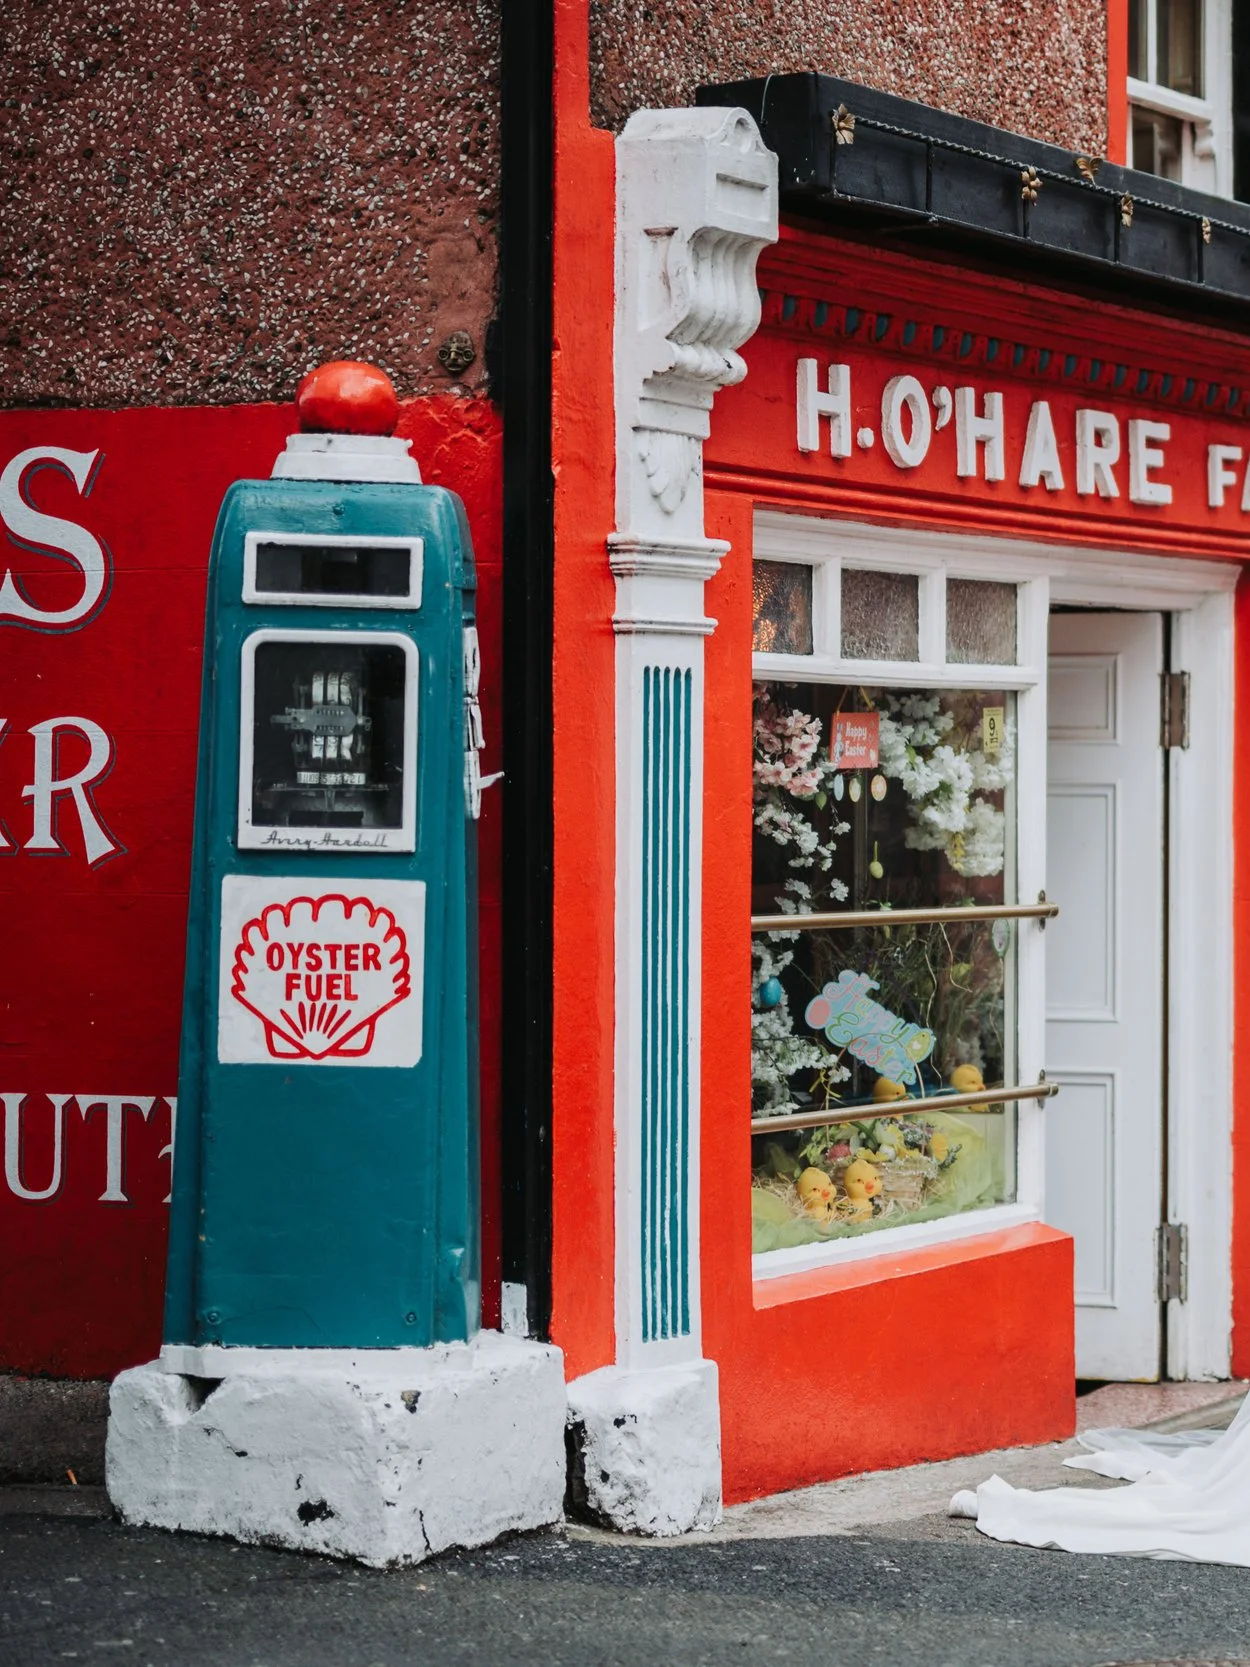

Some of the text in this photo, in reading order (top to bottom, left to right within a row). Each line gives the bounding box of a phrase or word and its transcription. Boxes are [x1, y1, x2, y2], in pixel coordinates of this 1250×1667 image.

[266, 942, 382, 972] OYSTER
[285, 973, 359, 1001] FUEL
[822, 976, 911, 1044] Happy
[827, 1011, 914, 1083] Easter
[0, 1092, 178, 1203] UT
